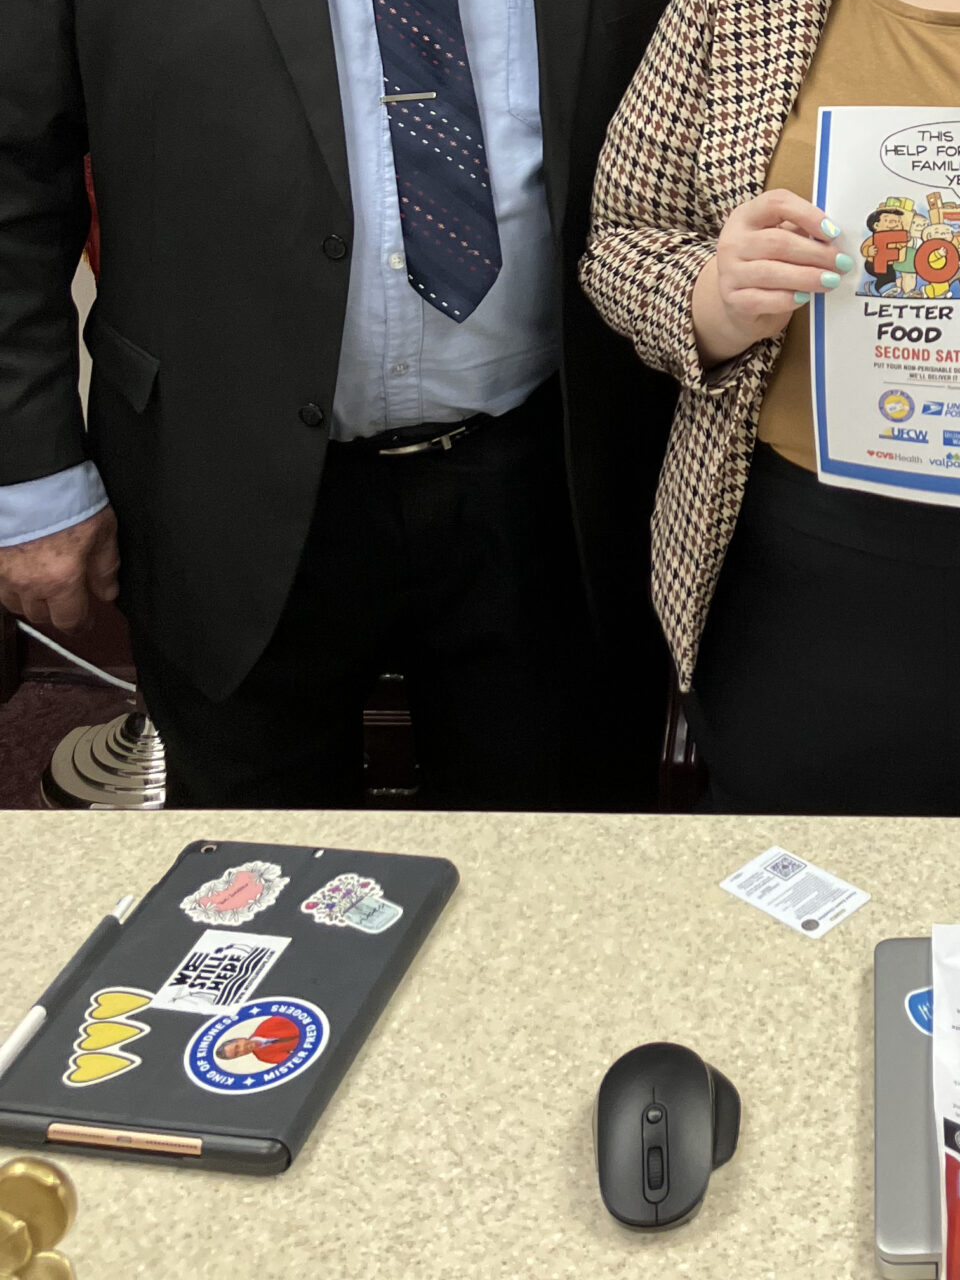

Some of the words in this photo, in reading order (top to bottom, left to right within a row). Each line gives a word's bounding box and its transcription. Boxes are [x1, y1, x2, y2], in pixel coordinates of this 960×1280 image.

[918, 130, 954, 142] THIS
[884, 144, 928, 156] HELP
[864, 301, 954, 320] LETTER
[876, 321, 943, 344] FOOD
[874, 345, 931, 362] SECOND
[891, 427, 928, 441] UFCW
[169, 952, 210, 986] WE
[189, 954, 226, 989] STILL
[206, 954, 241, 991] HERE
[271, 1004, 312, 1025] ROGERS
[197, 1015, 239, 1058] KINDNESS
[303, 1024, 317, 1049] FRED
[196, 1060, 210, 1071] OF
[263, 1051, 308, 1082] MISTER
[206, 1069, 235, 1086] KING
